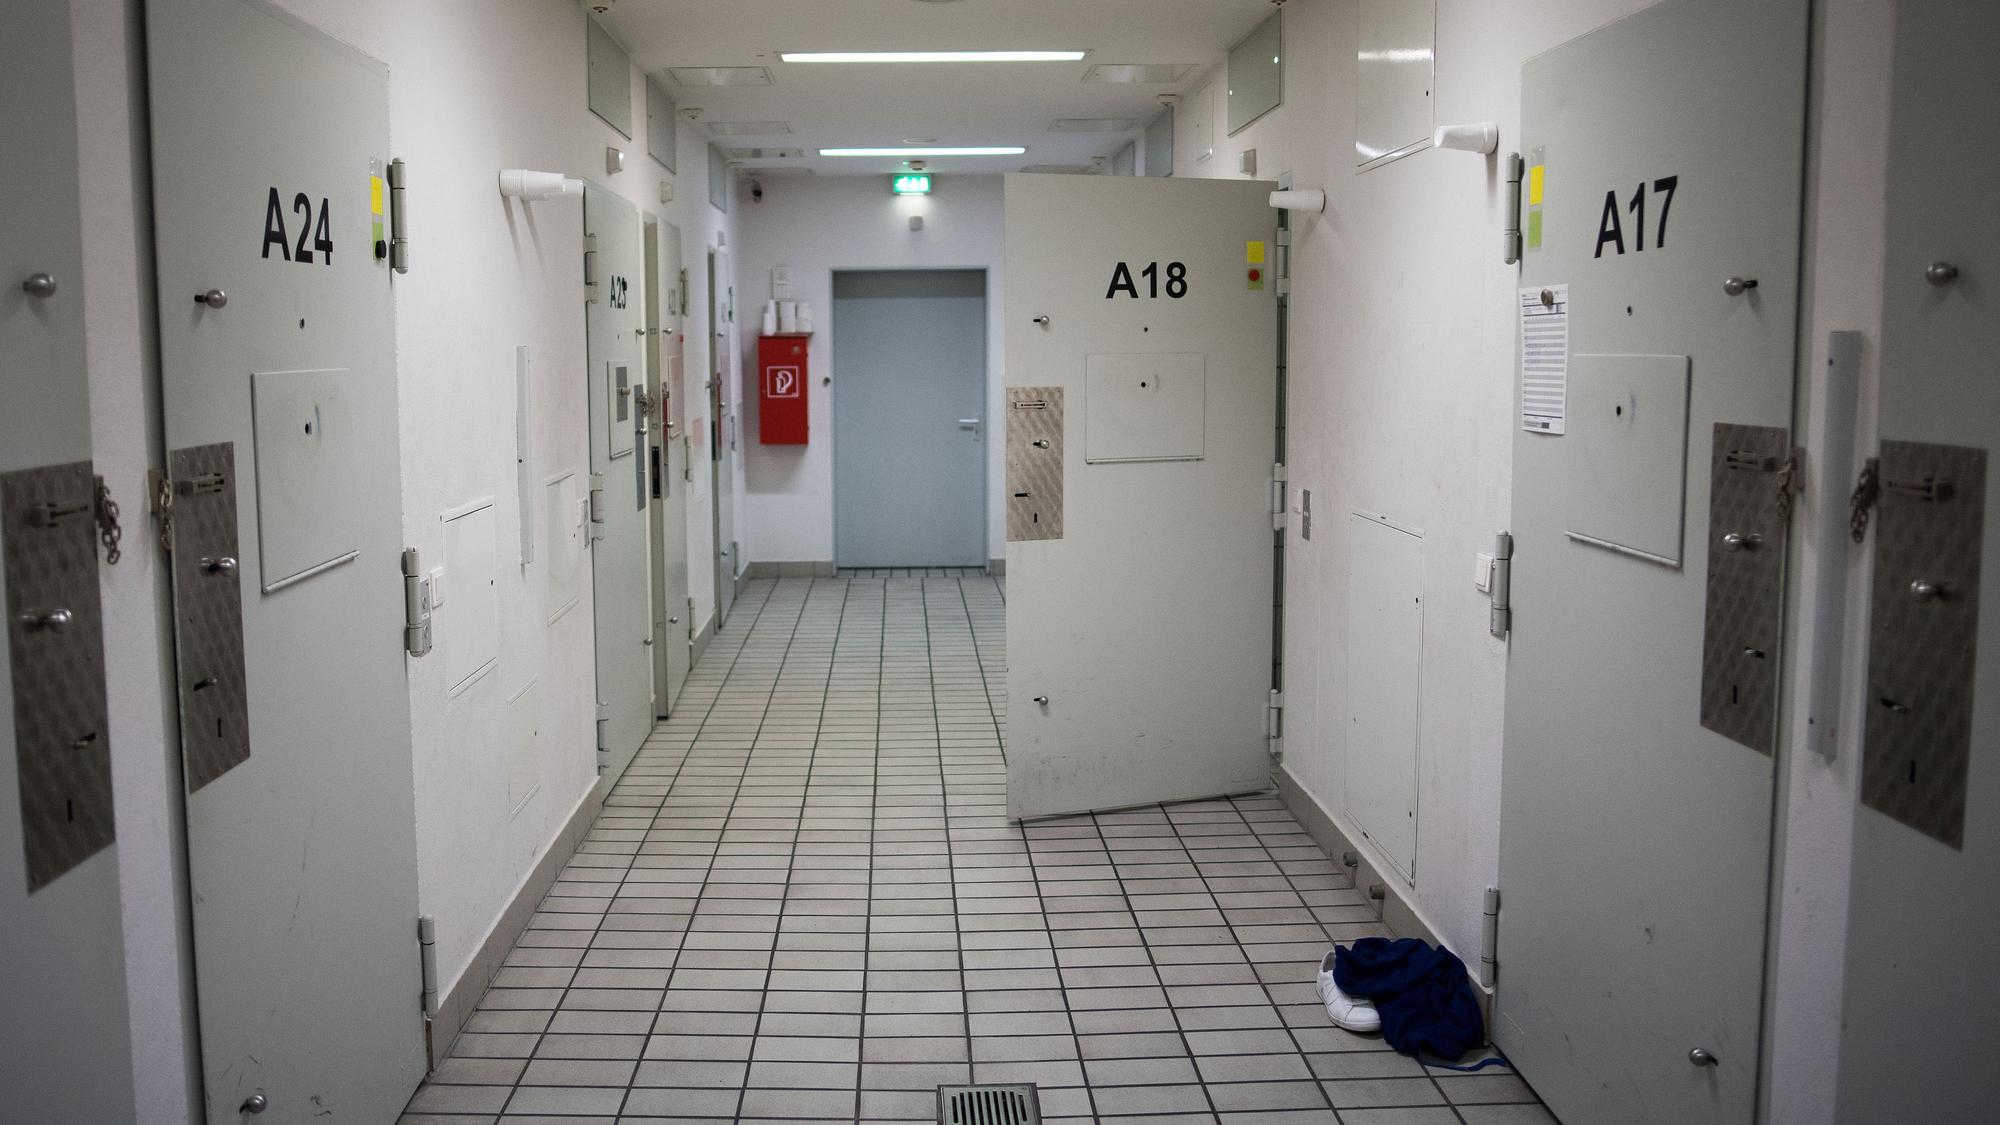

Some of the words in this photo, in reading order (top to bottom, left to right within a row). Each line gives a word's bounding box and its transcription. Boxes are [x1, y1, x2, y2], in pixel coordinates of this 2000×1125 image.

[262, 186, 333, 266] A24
[1594, 175, 1678, 258] A17
[1106, 261, 1187, 299] A18
